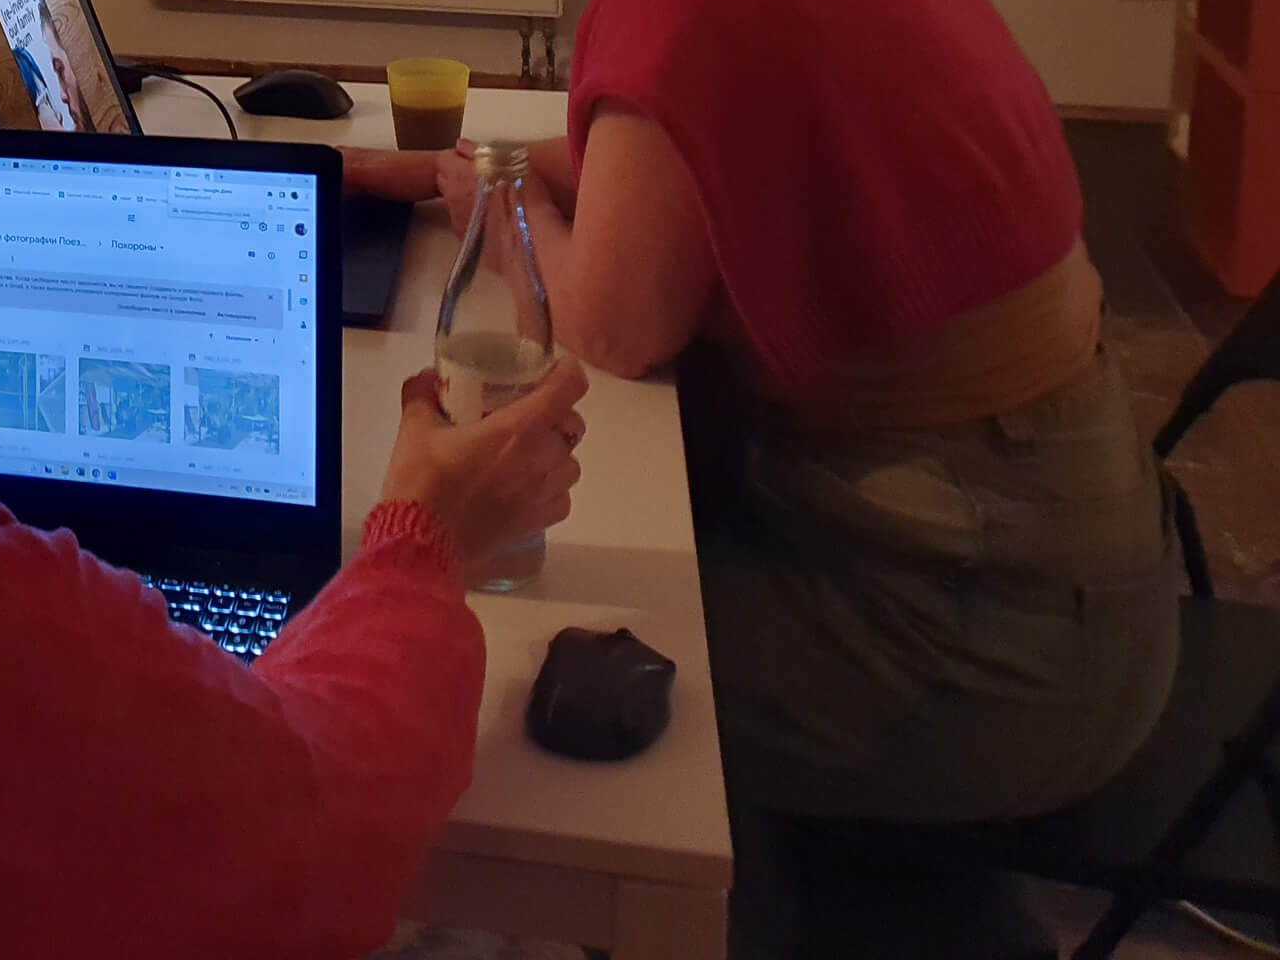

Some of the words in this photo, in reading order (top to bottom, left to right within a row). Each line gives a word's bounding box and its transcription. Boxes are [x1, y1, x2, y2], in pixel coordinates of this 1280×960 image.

[9, 22, 18, 39] our
[16, 7, 36, 30] family
[4, 233, 57, 246] фотографии
[112, 240, 157, 252] Похороны
